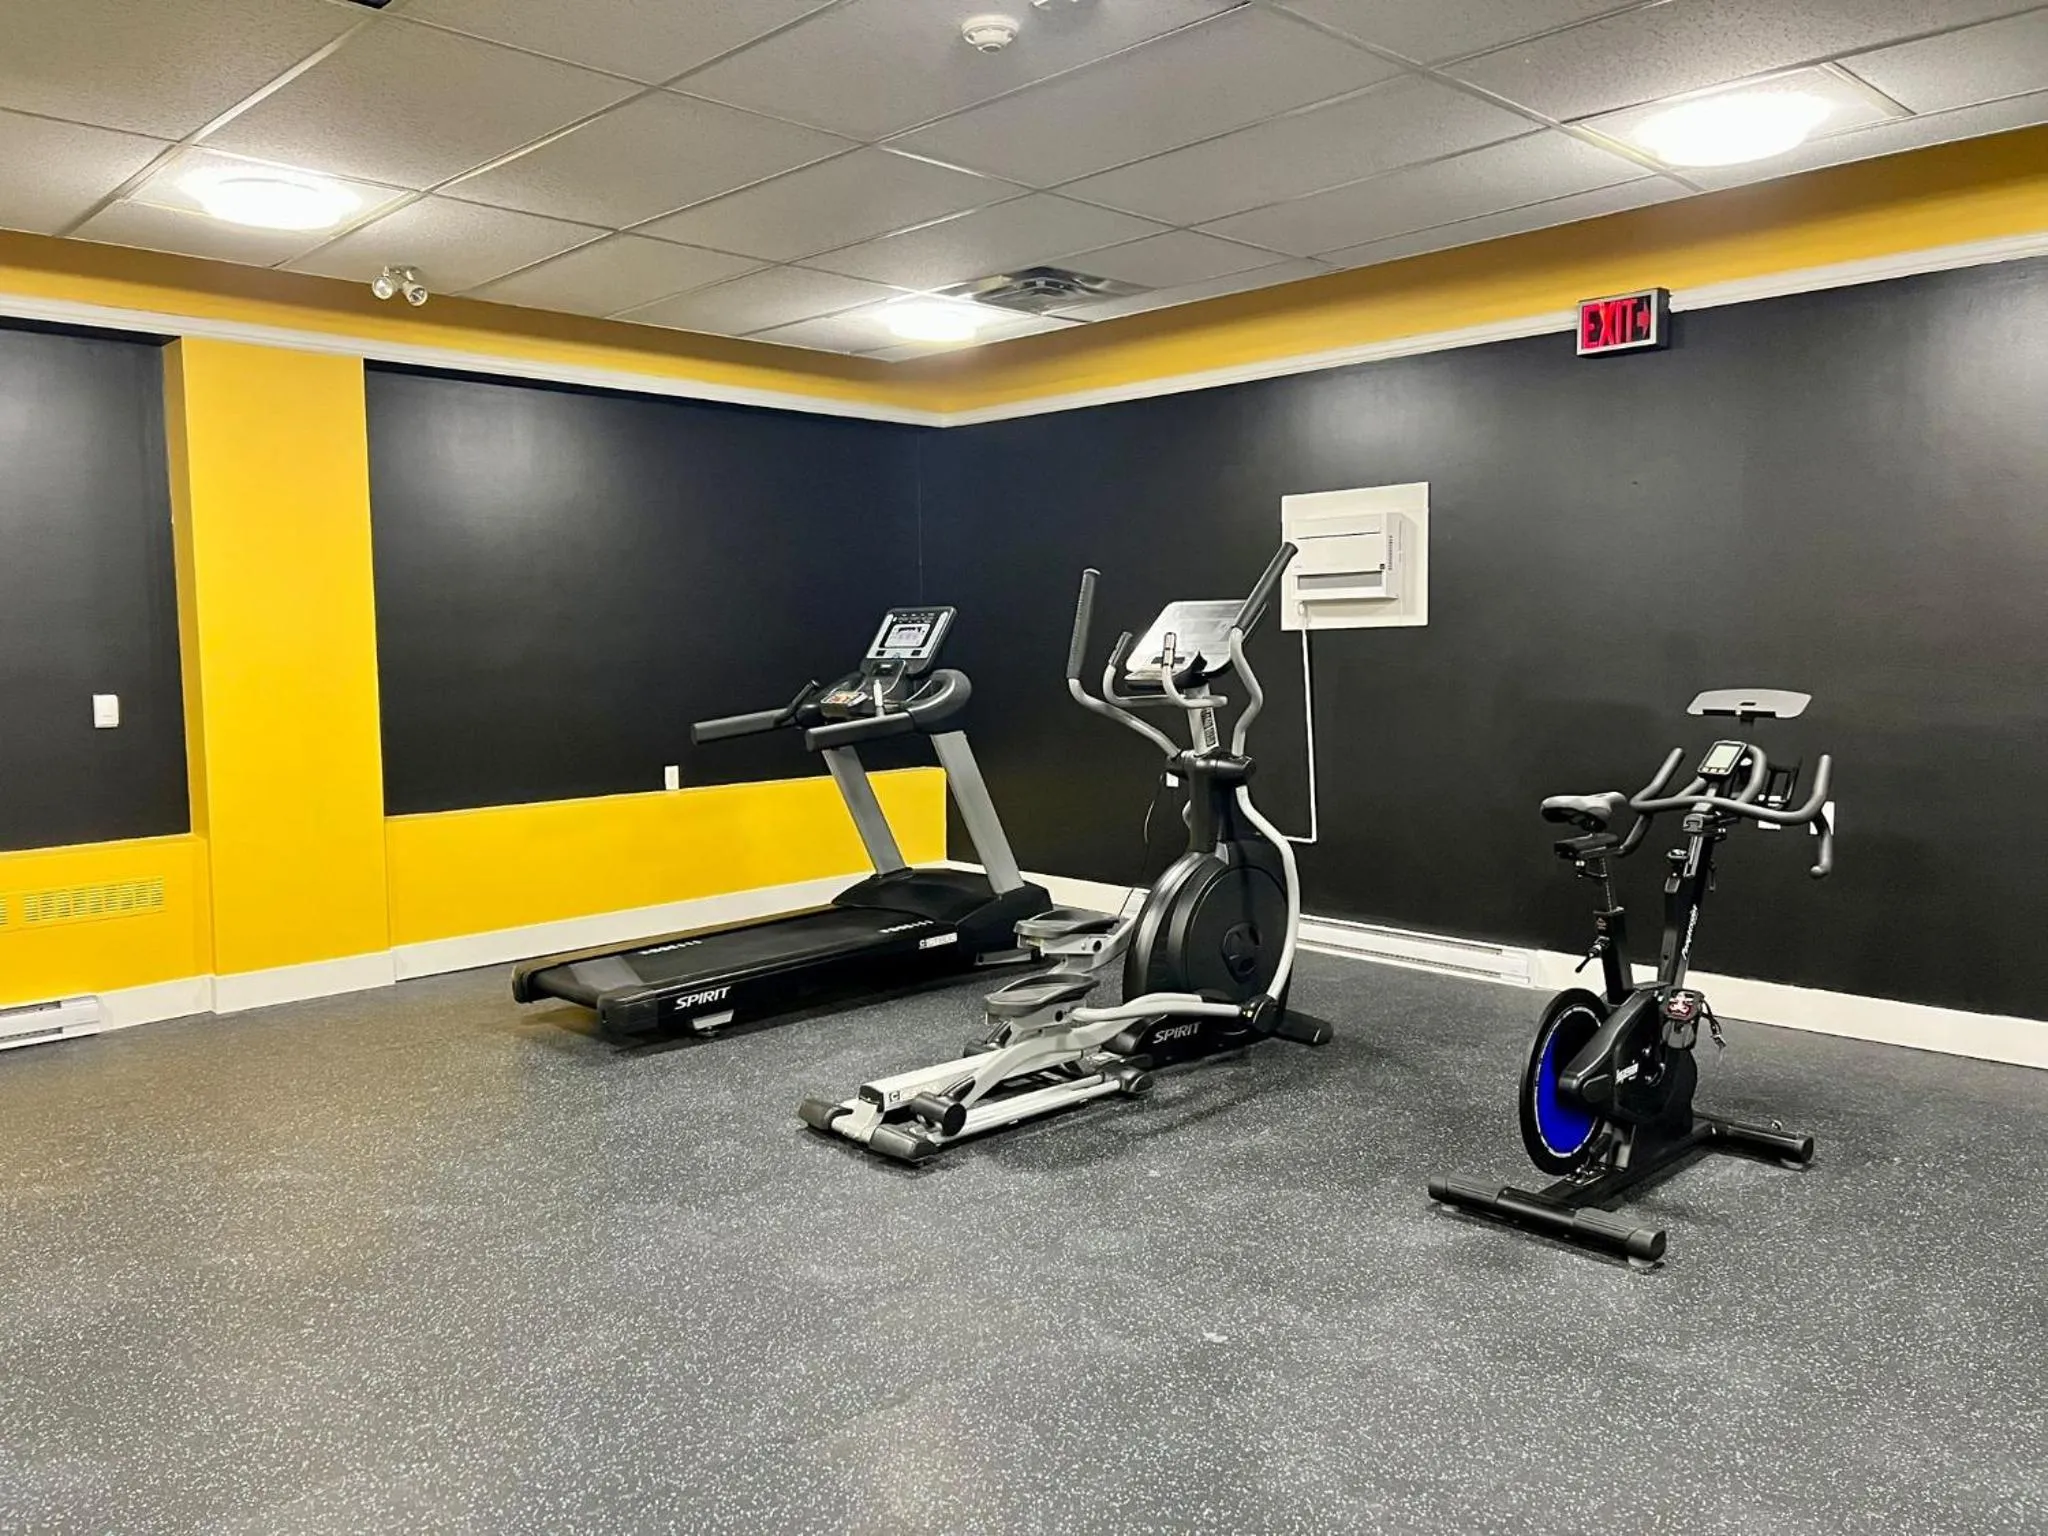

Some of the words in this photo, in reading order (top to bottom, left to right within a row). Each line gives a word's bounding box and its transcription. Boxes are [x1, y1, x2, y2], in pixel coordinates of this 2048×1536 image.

[1582, 299, 1637, 349] EXIT
[674, 986, 731, 1010] SPIRIT
[1152, 1021, 1202, 1044] SPIRIT
